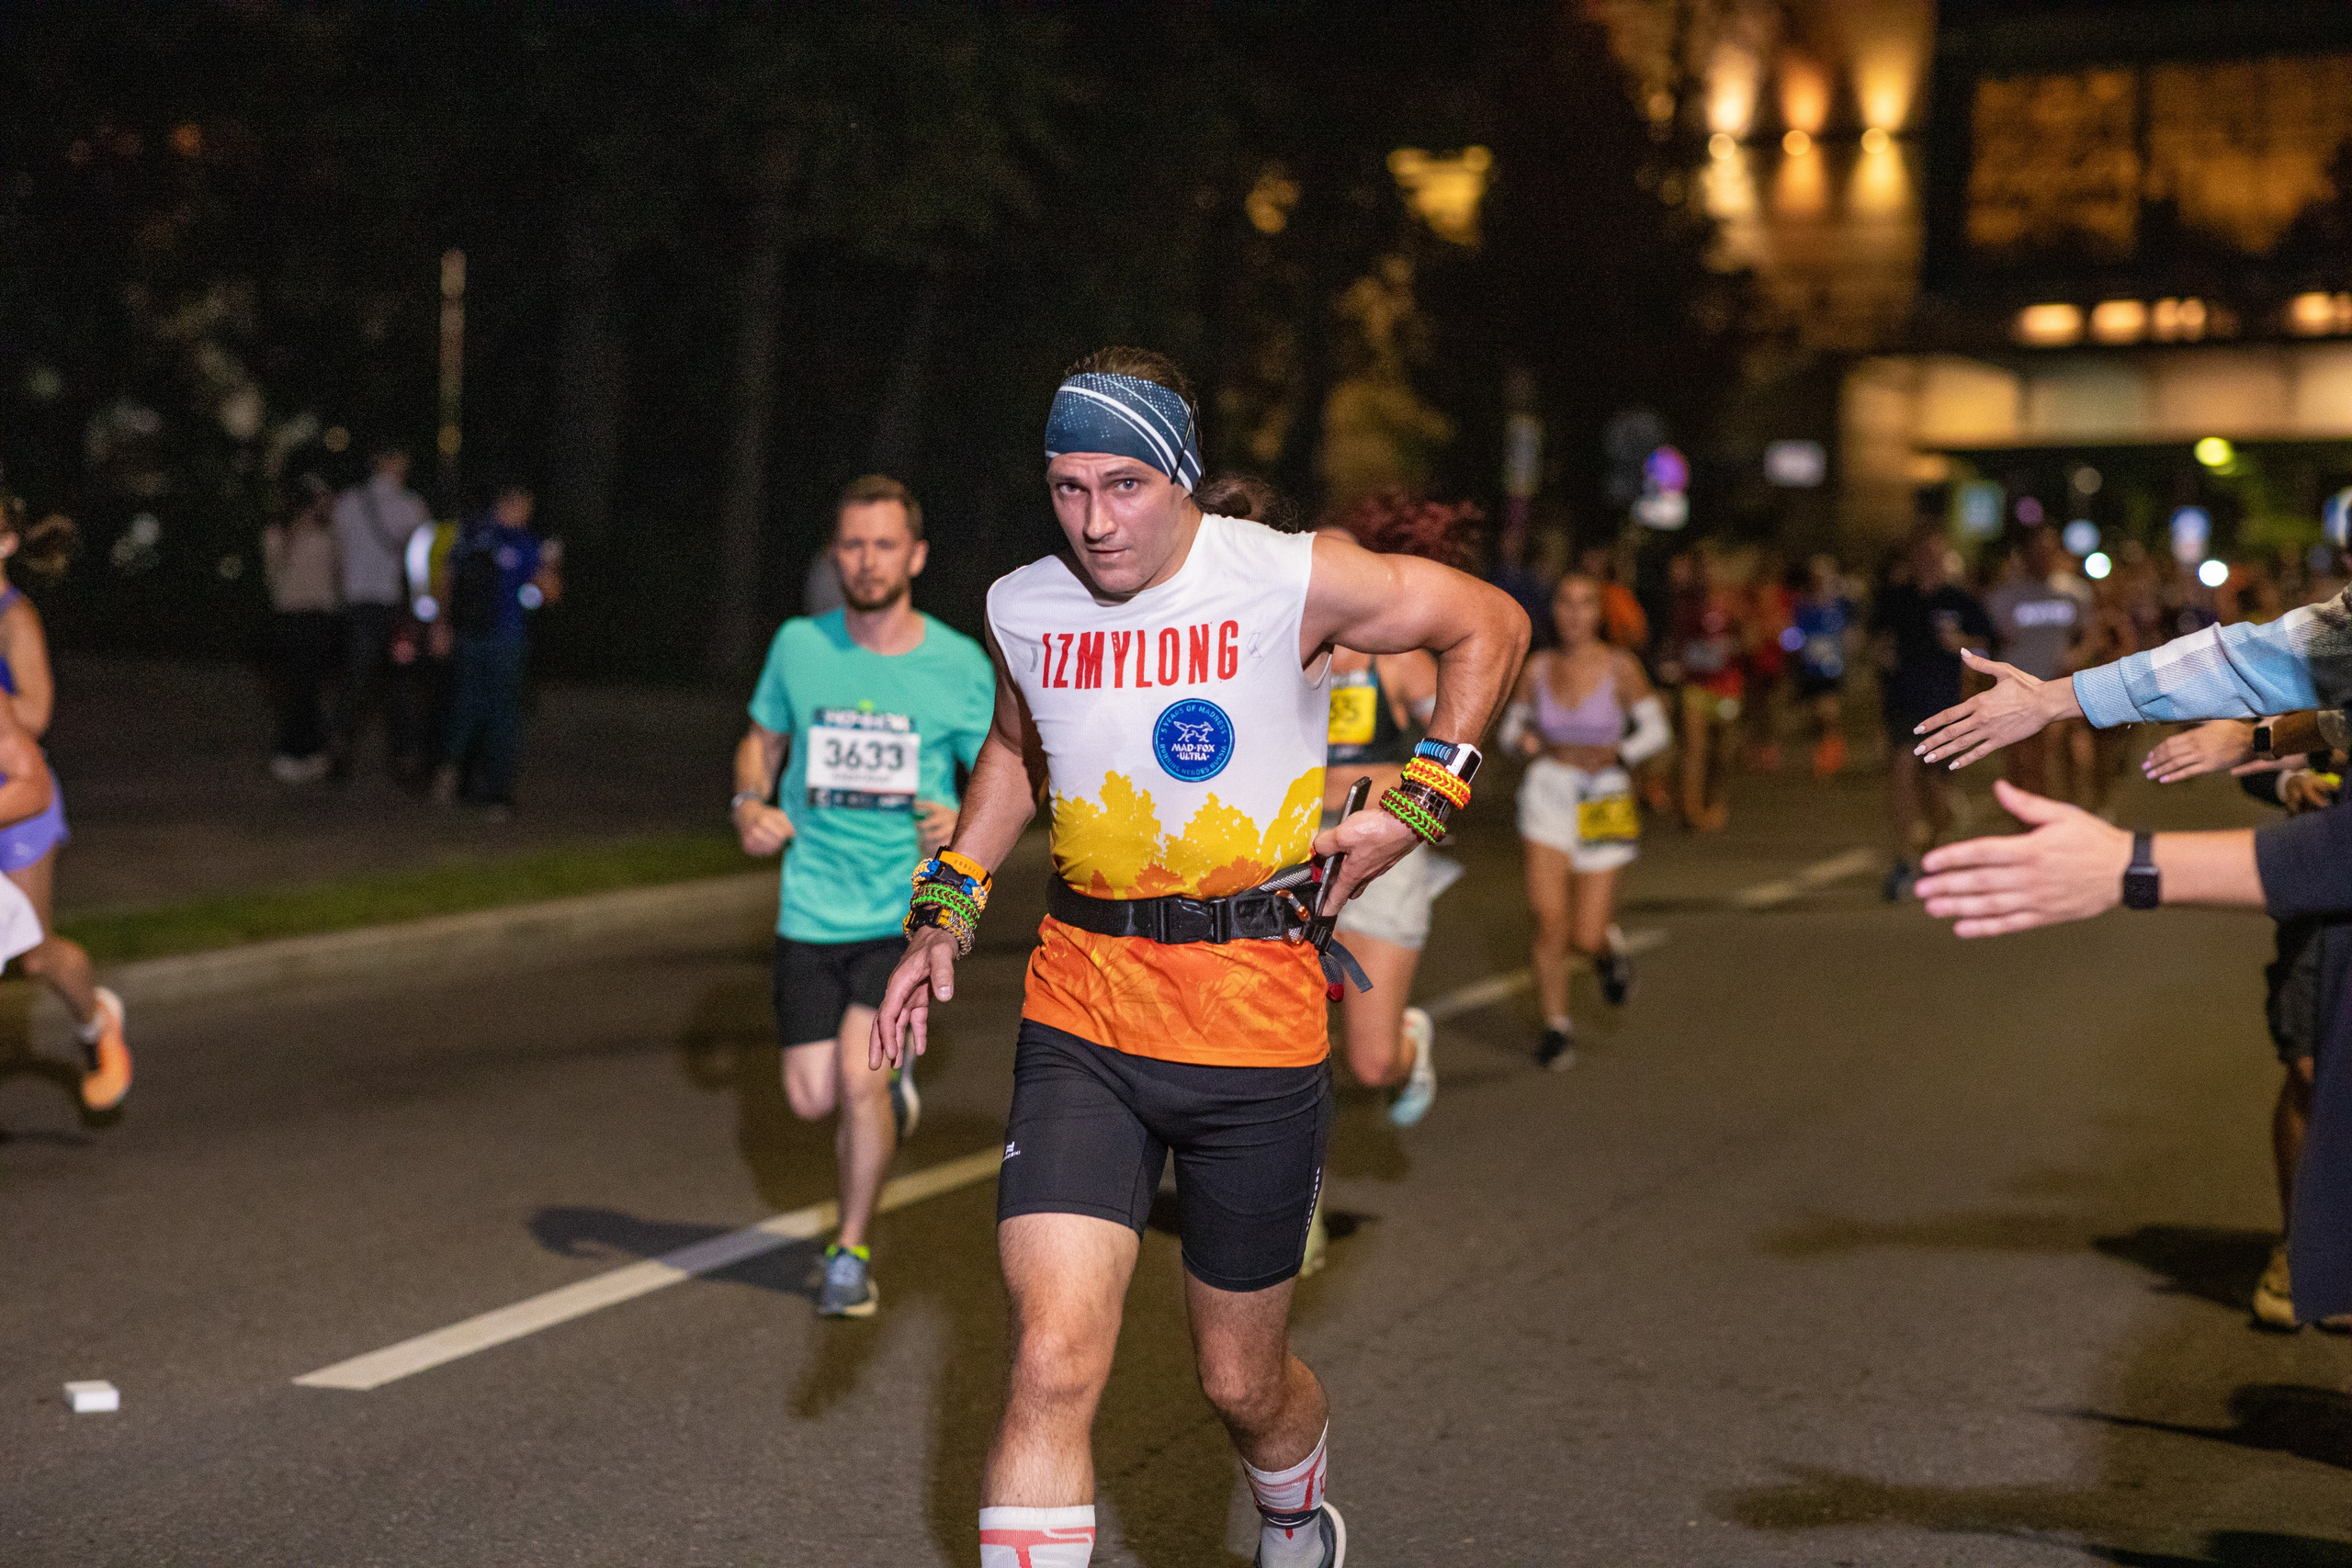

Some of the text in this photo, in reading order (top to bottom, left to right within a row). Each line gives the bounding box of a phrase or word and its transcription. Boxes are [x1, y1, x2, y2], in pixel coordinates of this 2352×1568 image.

[1042, 620, 1239, 689] IZMYLONG
[1163, 706, 1184, 727] YEARS
[1198, 705, 1227, 734] MADNESS
[824, 738, 904, 771] 3633
[1159, 743, 1227, 775] RUNNING HEROES RUSSIA
